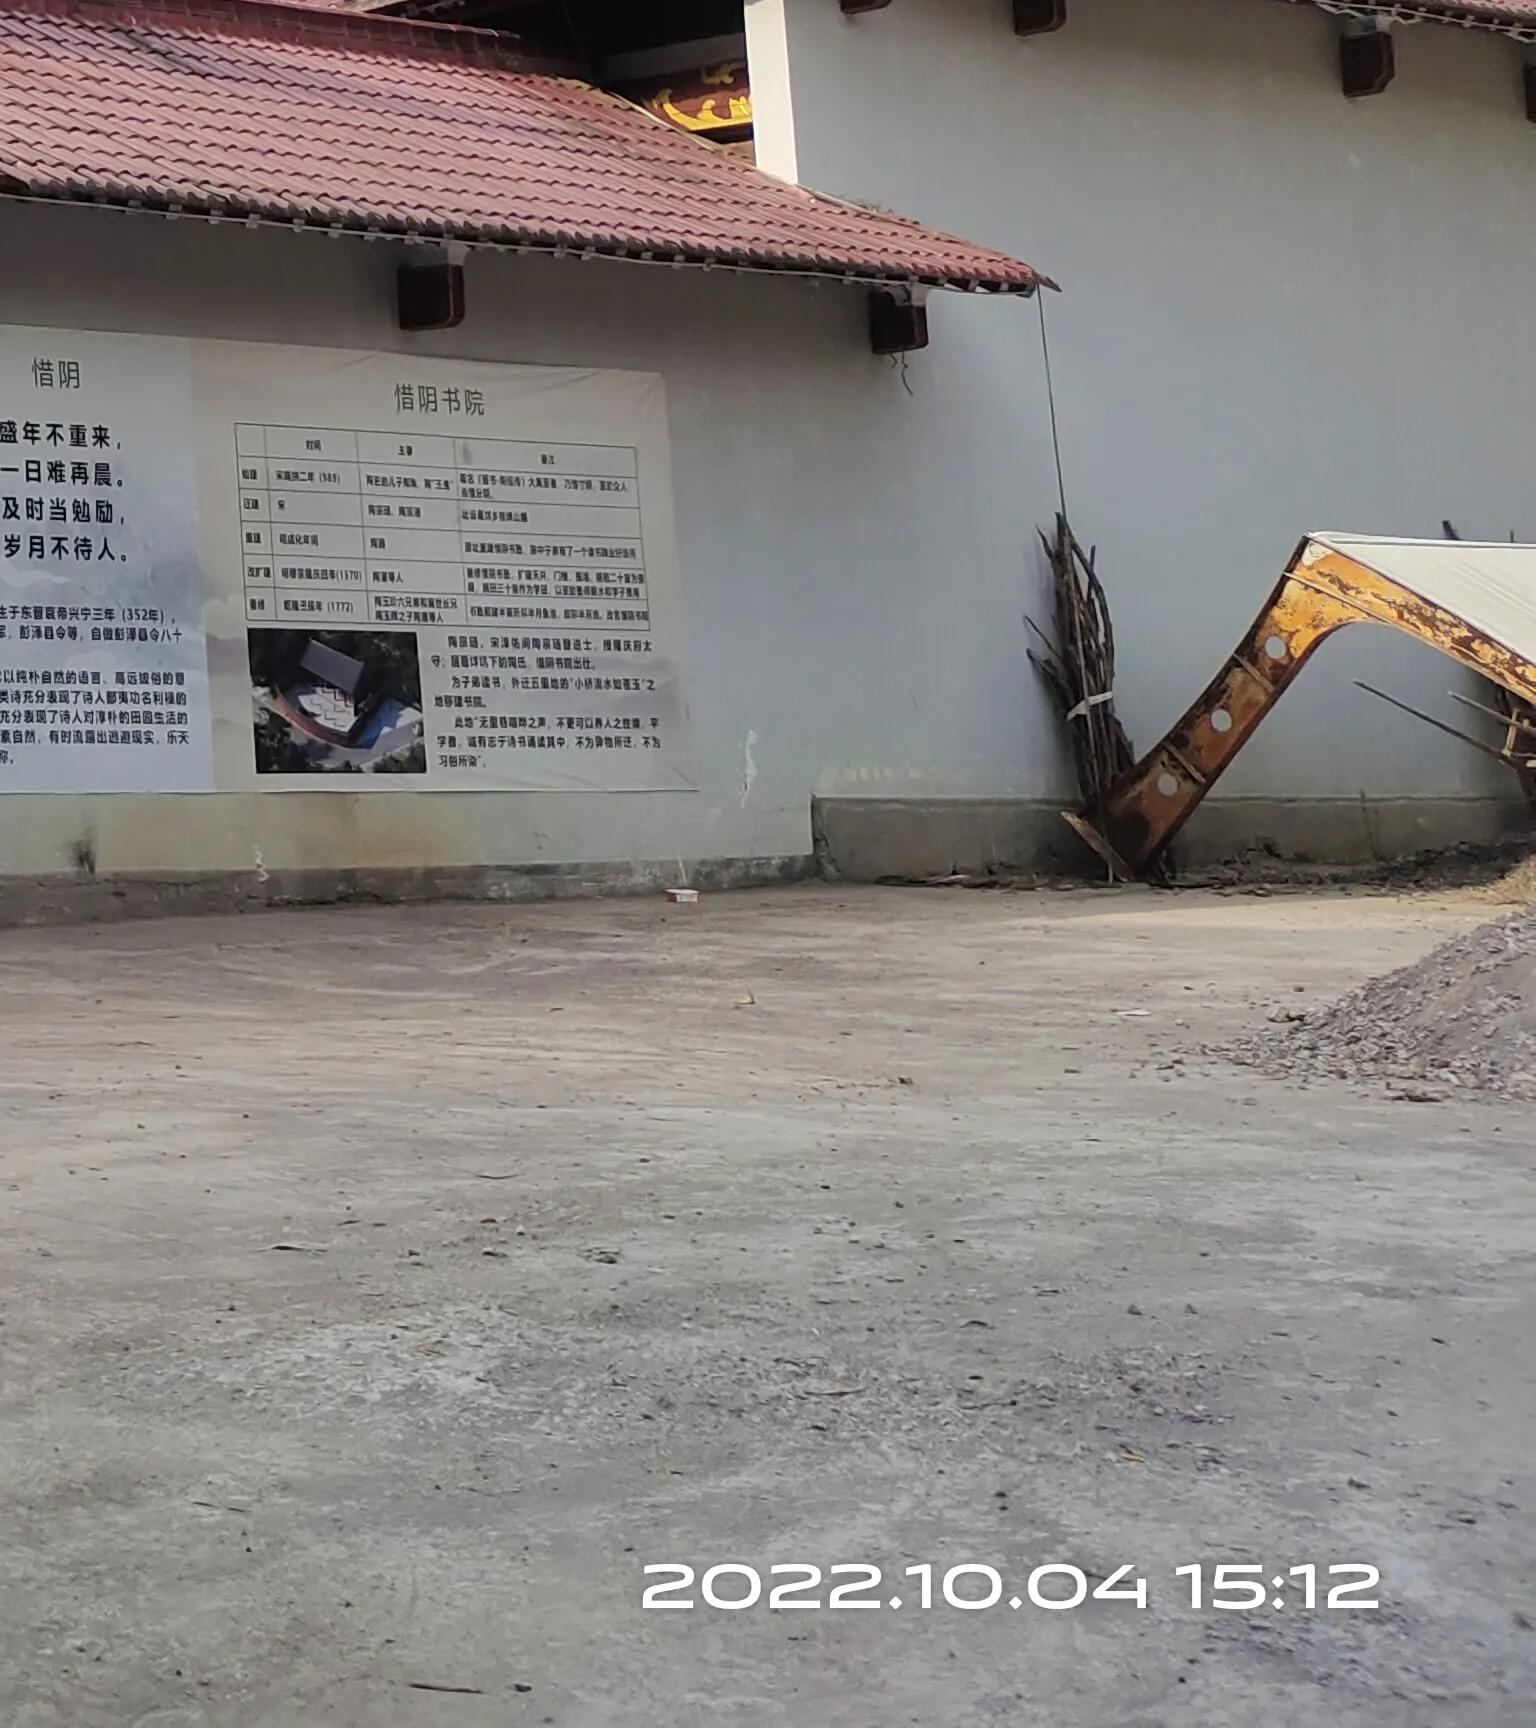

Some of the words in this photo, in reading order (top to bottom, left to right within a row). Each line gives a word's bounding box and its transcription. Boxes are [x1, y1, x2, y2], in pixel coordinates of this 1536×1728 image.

[31, 357, 81, 390] 惜阴
[394, 383, 485, 416] 惜阴书院
